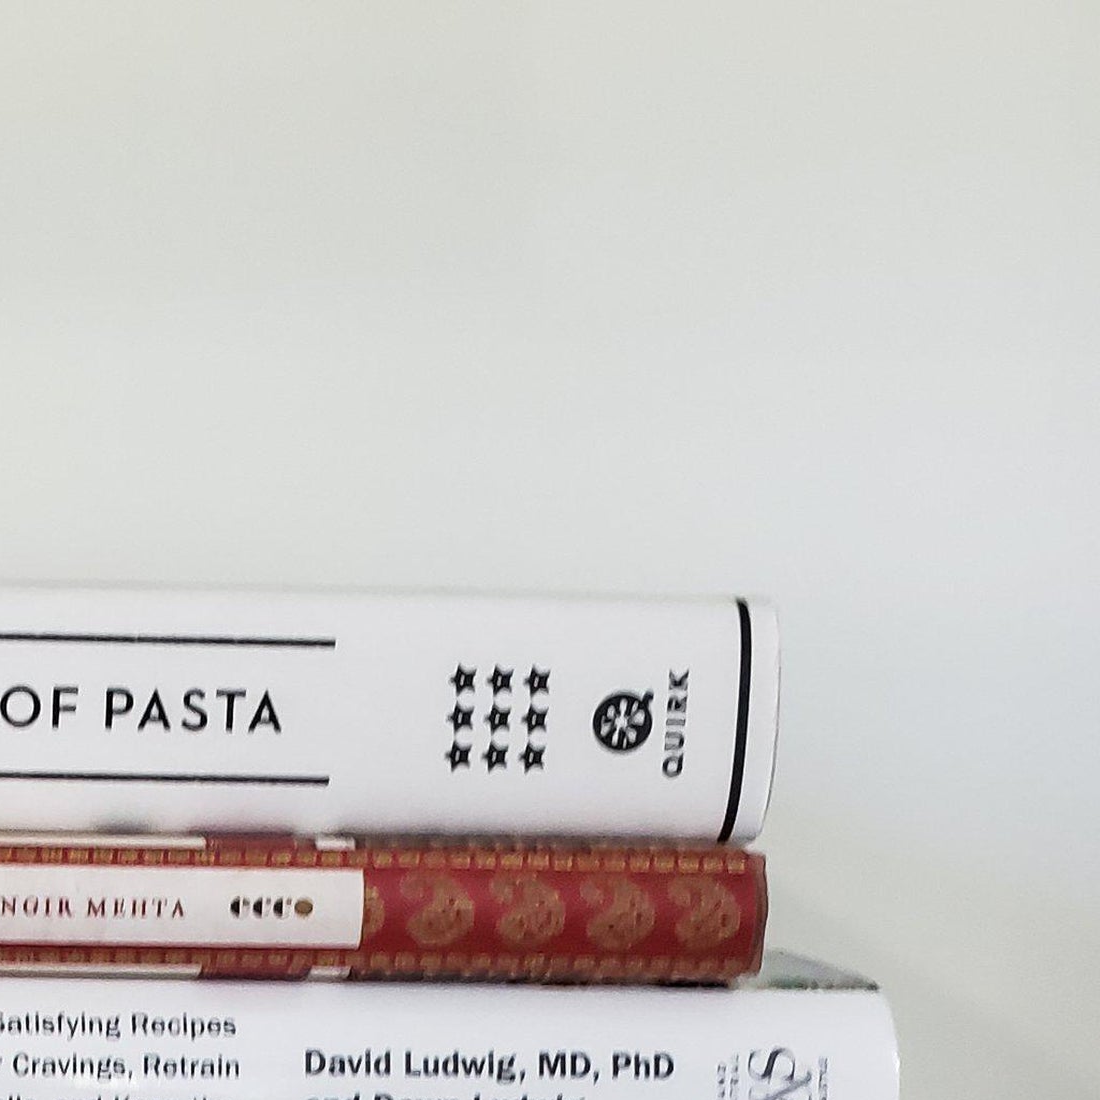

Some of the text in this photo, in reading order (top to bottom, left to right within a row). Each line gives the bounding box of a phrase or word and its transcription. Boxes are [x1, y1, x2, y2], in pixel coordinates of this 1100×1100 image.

[0, 685, 78, 730] OF
[105, 687, 282, 734] PASTA
[662, 668, 689, 779] QUIRK
[87, 896, 185, 919] MEHTA
[131, 1011, 237, 1040] Recipes
[12, 1052, 133, 1080] Cravings,
[142, 1054, 240, 1079] Retrain
[304, 1049, 674, 1085] David Ludwig, MD, PhD
